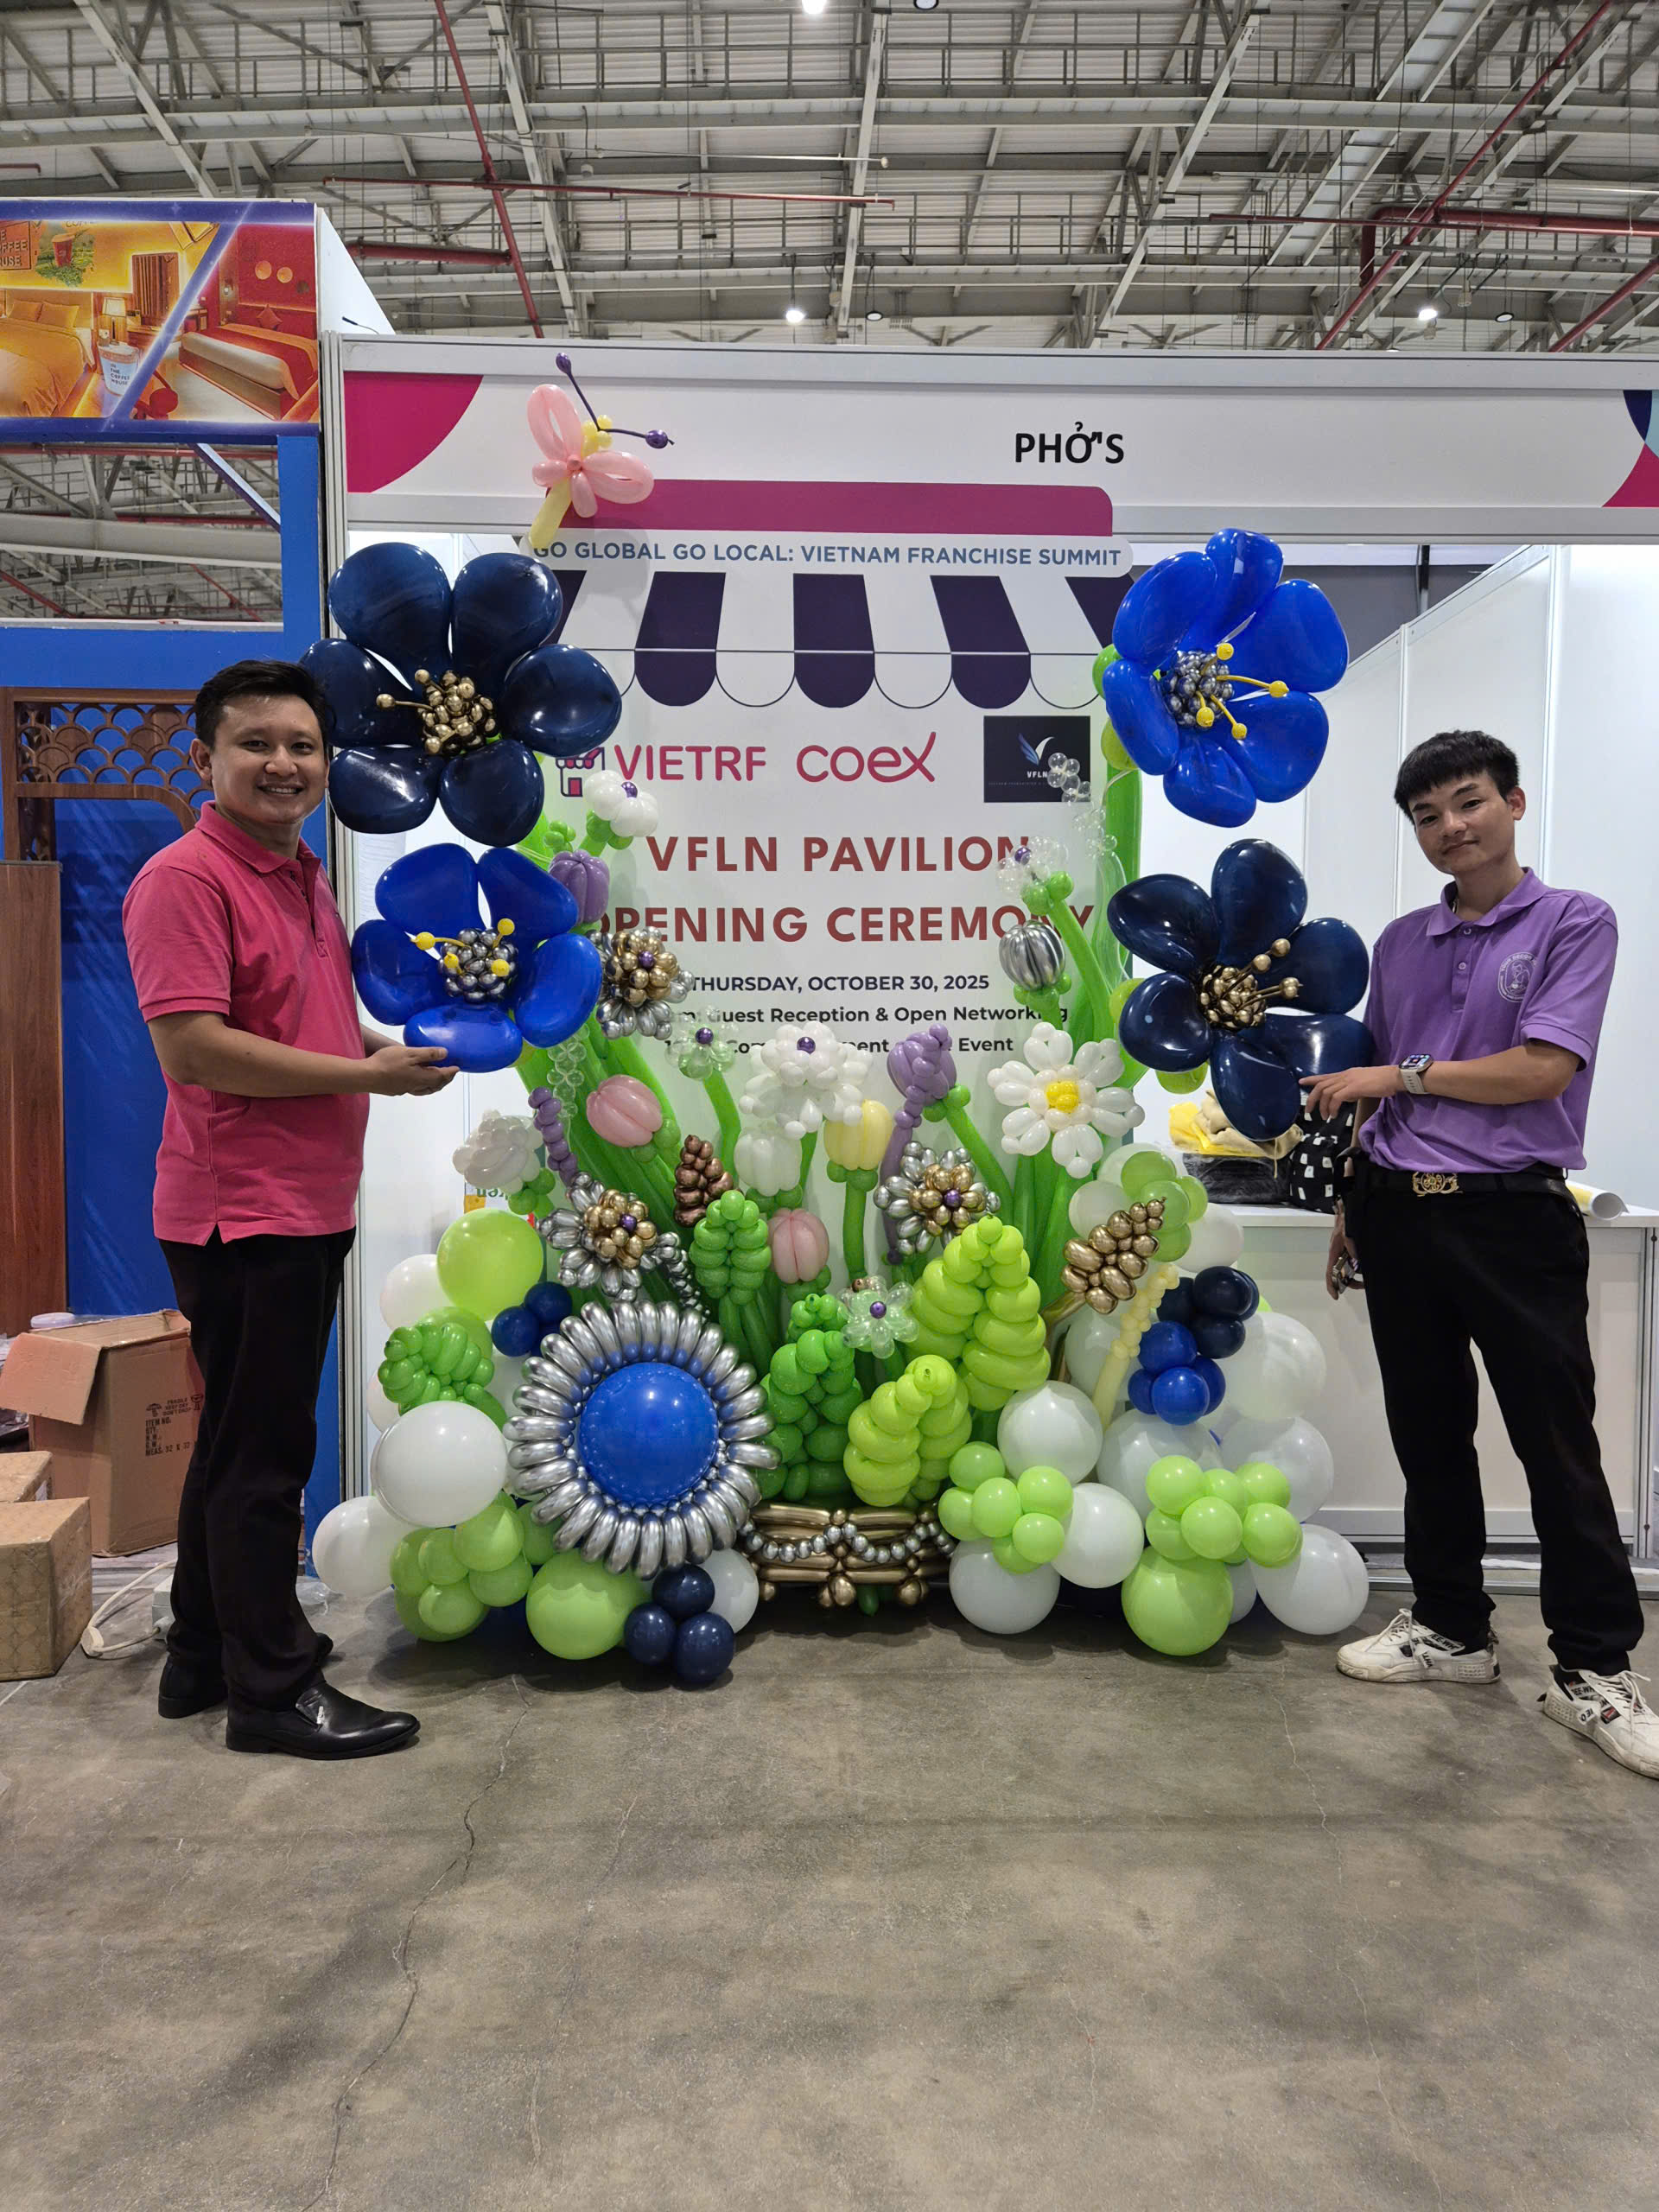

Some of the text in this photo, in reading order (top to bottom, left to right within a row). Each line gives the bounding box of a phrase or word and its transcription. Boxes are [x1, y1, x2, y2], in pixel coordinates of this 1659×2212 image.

[0, 239, 28, 255] FFEE
[0, 256, 22, 267] USE
[575, 542, 665, 560] GLOBAL
[673, 543, 706, 560] GO
[715, 544, 793, 562] LOCAL:
[801, 545, 899, 563] VIETNAM
[907, 546, 1032, 564] FRANCHISE
[1039, 548, 1122, 566] SUMMIT
[613, 745, 766, 781] VIETRF
[645, 836, 778, 872] VFLN
[600, 905, 1095, 943] PENING CEREMOY
[693, 975, 989, 994] THURSDAY, OCTOBER 30, 2025
[770, 1006, 869, 1025] Reception
[875, 1007, 888, 1021] &
[894, 1007, 947, 1025] Open
[953, 1005, 1068, 1023] Networkg
[958, 1037, 1014, 1052] Event
